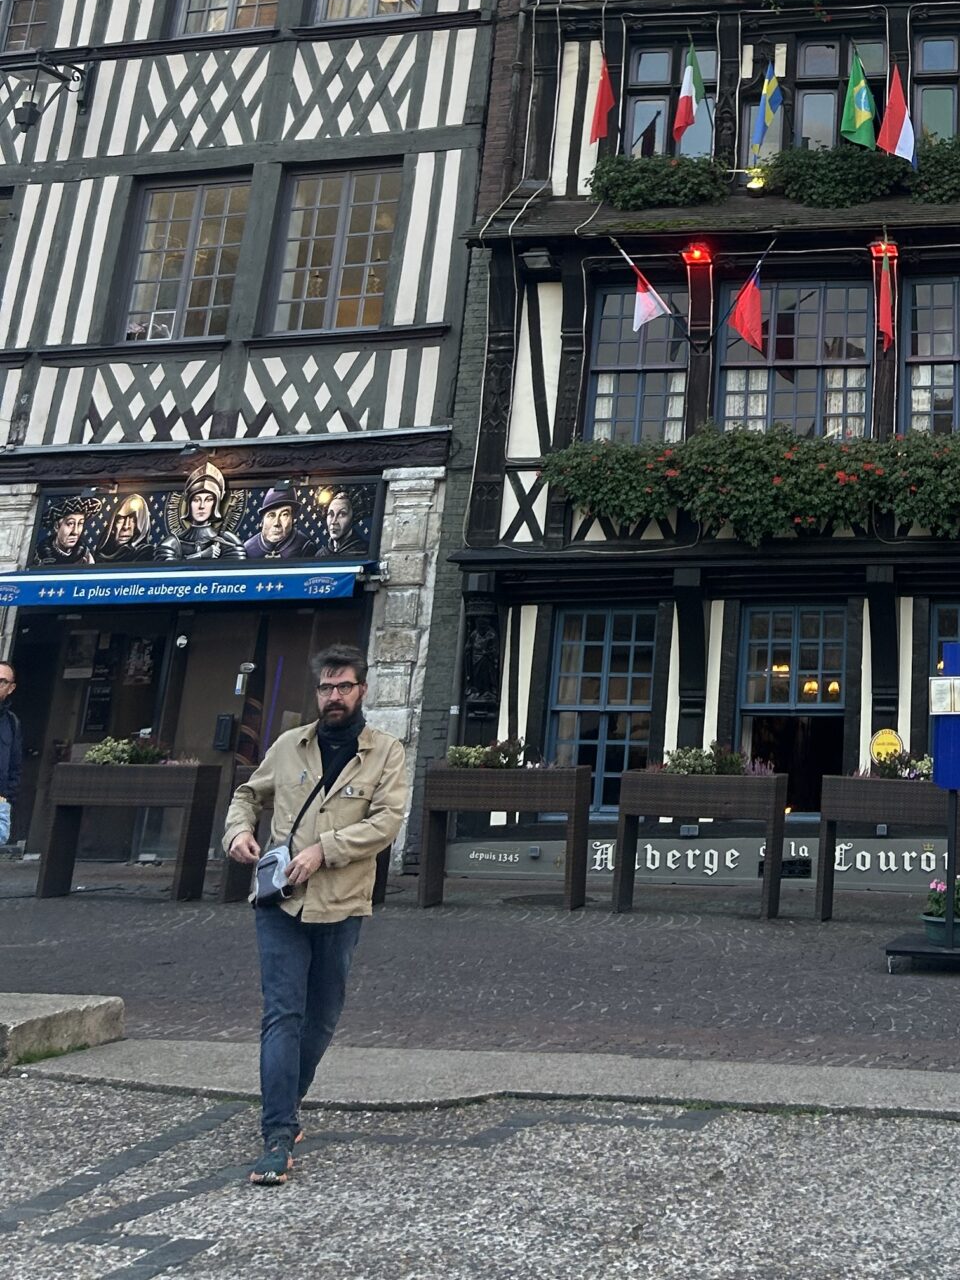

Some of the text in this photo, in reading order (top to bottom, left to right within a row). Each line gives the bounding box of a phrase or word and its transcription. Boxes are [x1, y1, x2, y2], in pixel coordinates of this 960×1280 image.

[72, 582, 247, 600] La plus vieille auberge de France
[308, 585, 331, 595] 1345
[0, 593, 14, 602] 45
[469, 850, 520, 863] depuis 1345
[591, 841, 741, 876] Aberge
[789, 841, 809, 857] la
